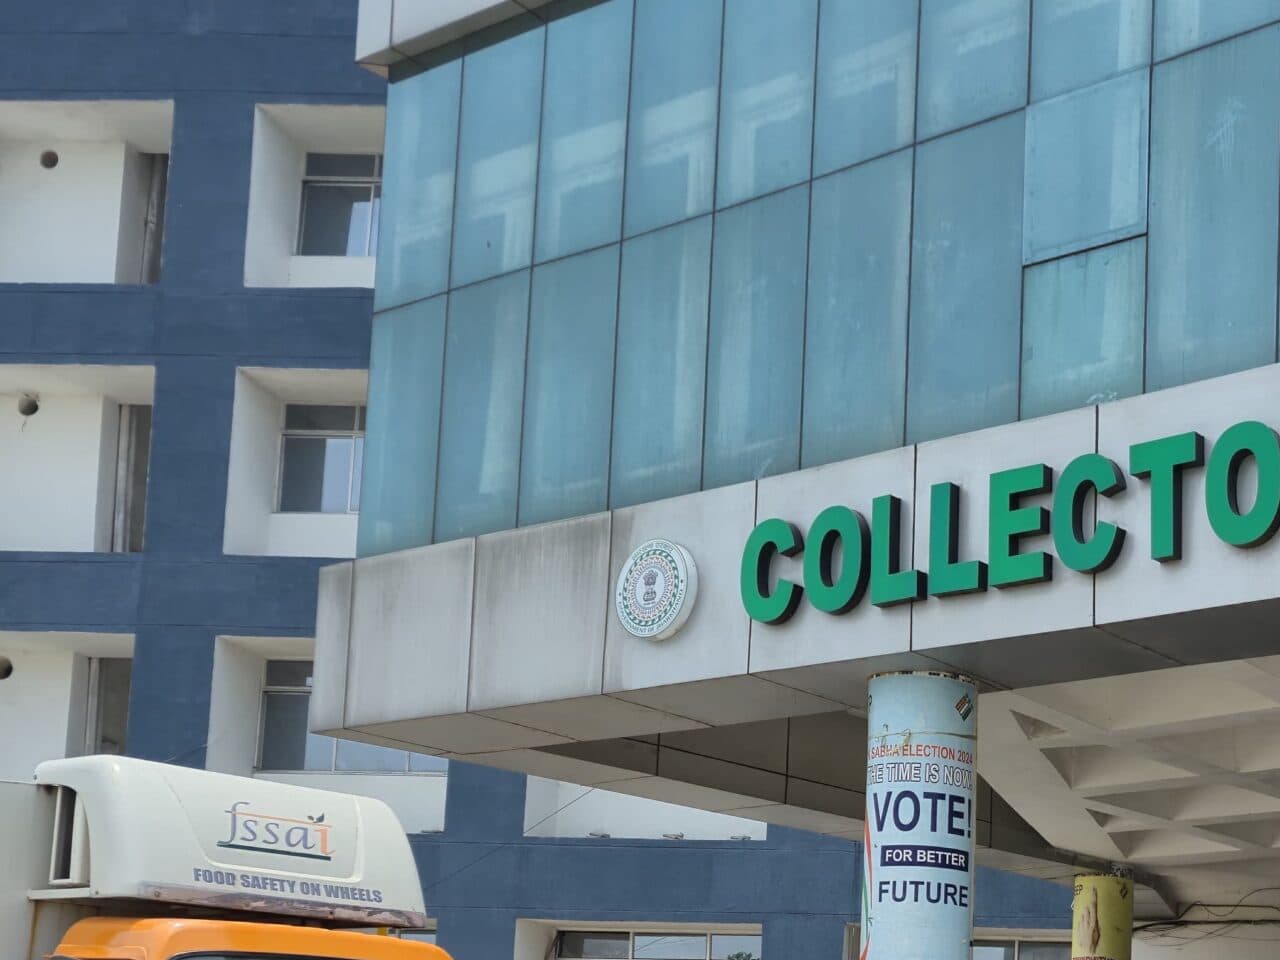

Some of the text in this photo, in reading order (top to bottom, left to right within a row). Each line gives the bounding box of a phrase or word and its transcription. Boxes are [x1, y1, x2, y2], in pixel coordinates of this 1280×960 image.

[902, 744, 955, 760] ELECTION
[957, 751, 973, 764] 2024
[886, 762, 921, 782] TIME
[925, 763, 939, 783] IS
[873, 790, 972, 839] VOTE!
[217, 801, 336, 856] fssai
[885, 849, 966, 867] FOR BETTER
[193, 868, 383, 903] FOOD SAFETY ON WHEELS
[878, 880, 969, 907] FUTURE
